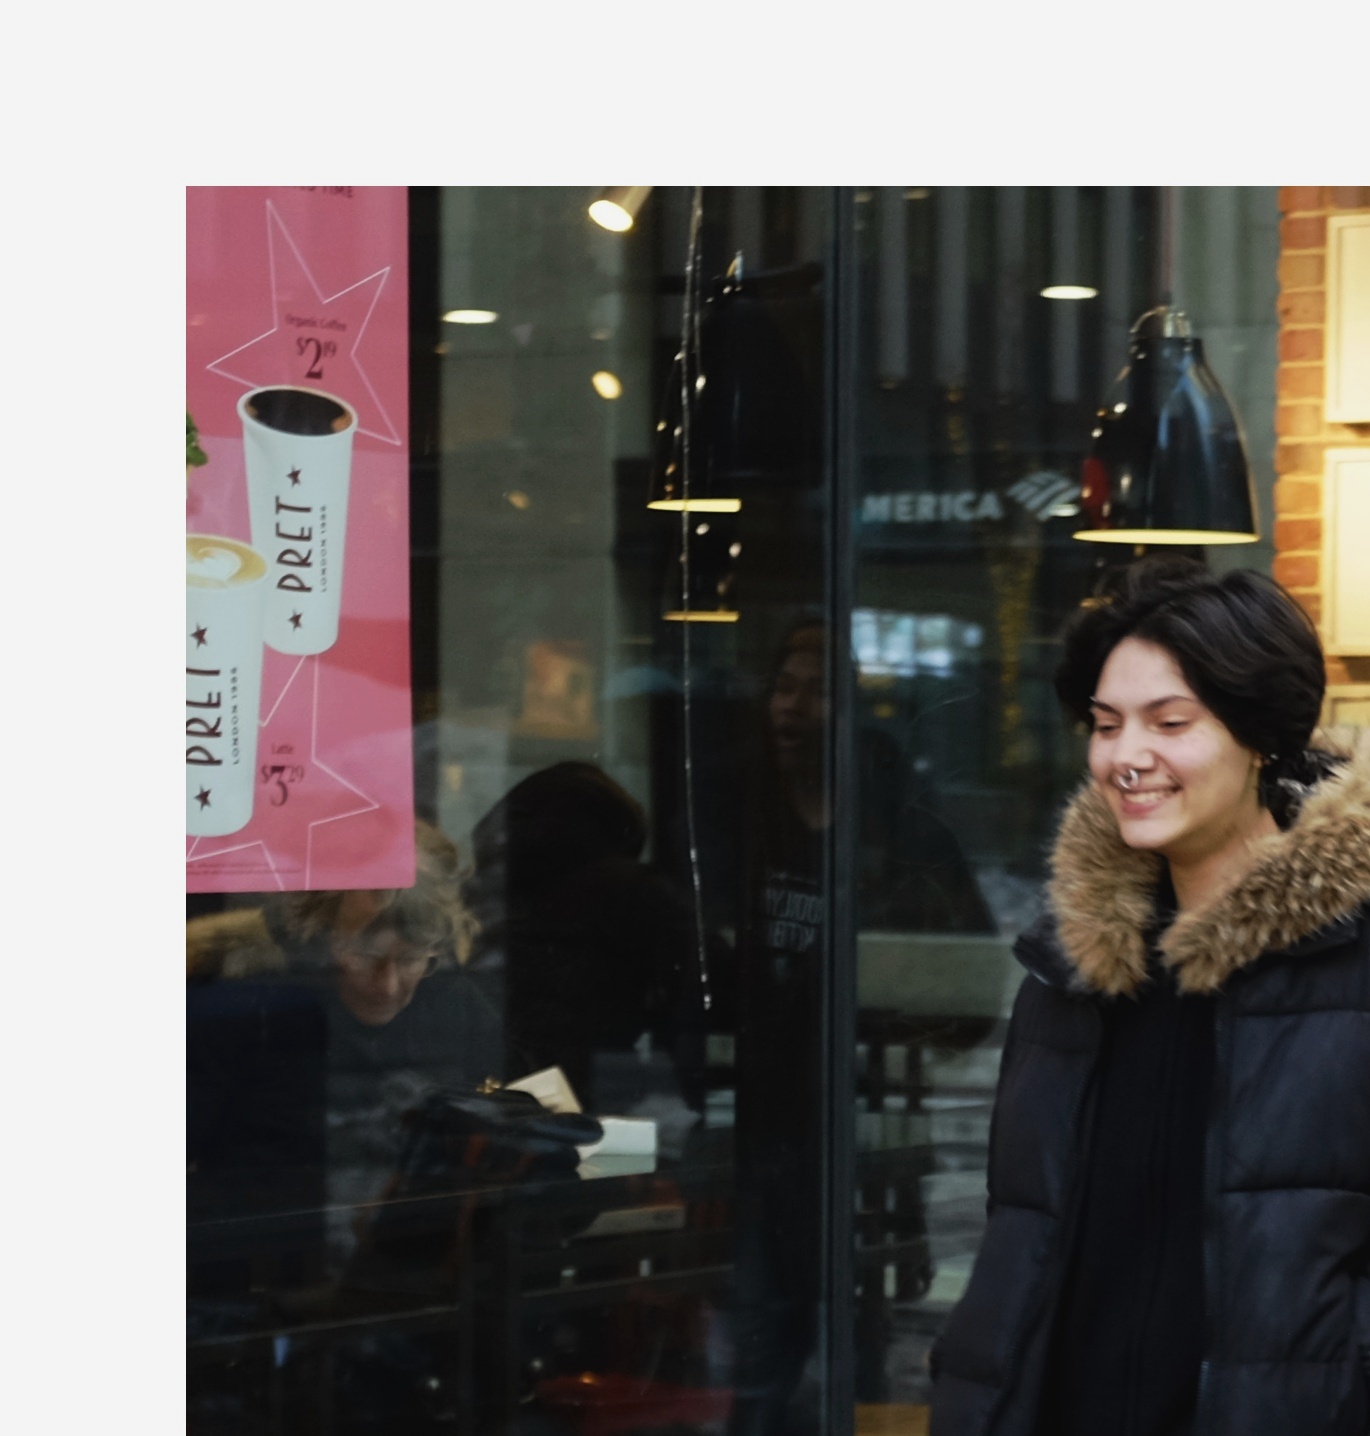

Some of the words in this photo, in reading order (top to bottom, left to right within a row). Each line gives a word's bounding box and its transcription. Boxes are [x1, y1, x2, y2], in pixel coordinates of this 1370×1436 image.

[862, 491, 1003, 522] MERICA
[275, 495, 312, 592] PRET
[231, 705, 239, 764] LONDON
